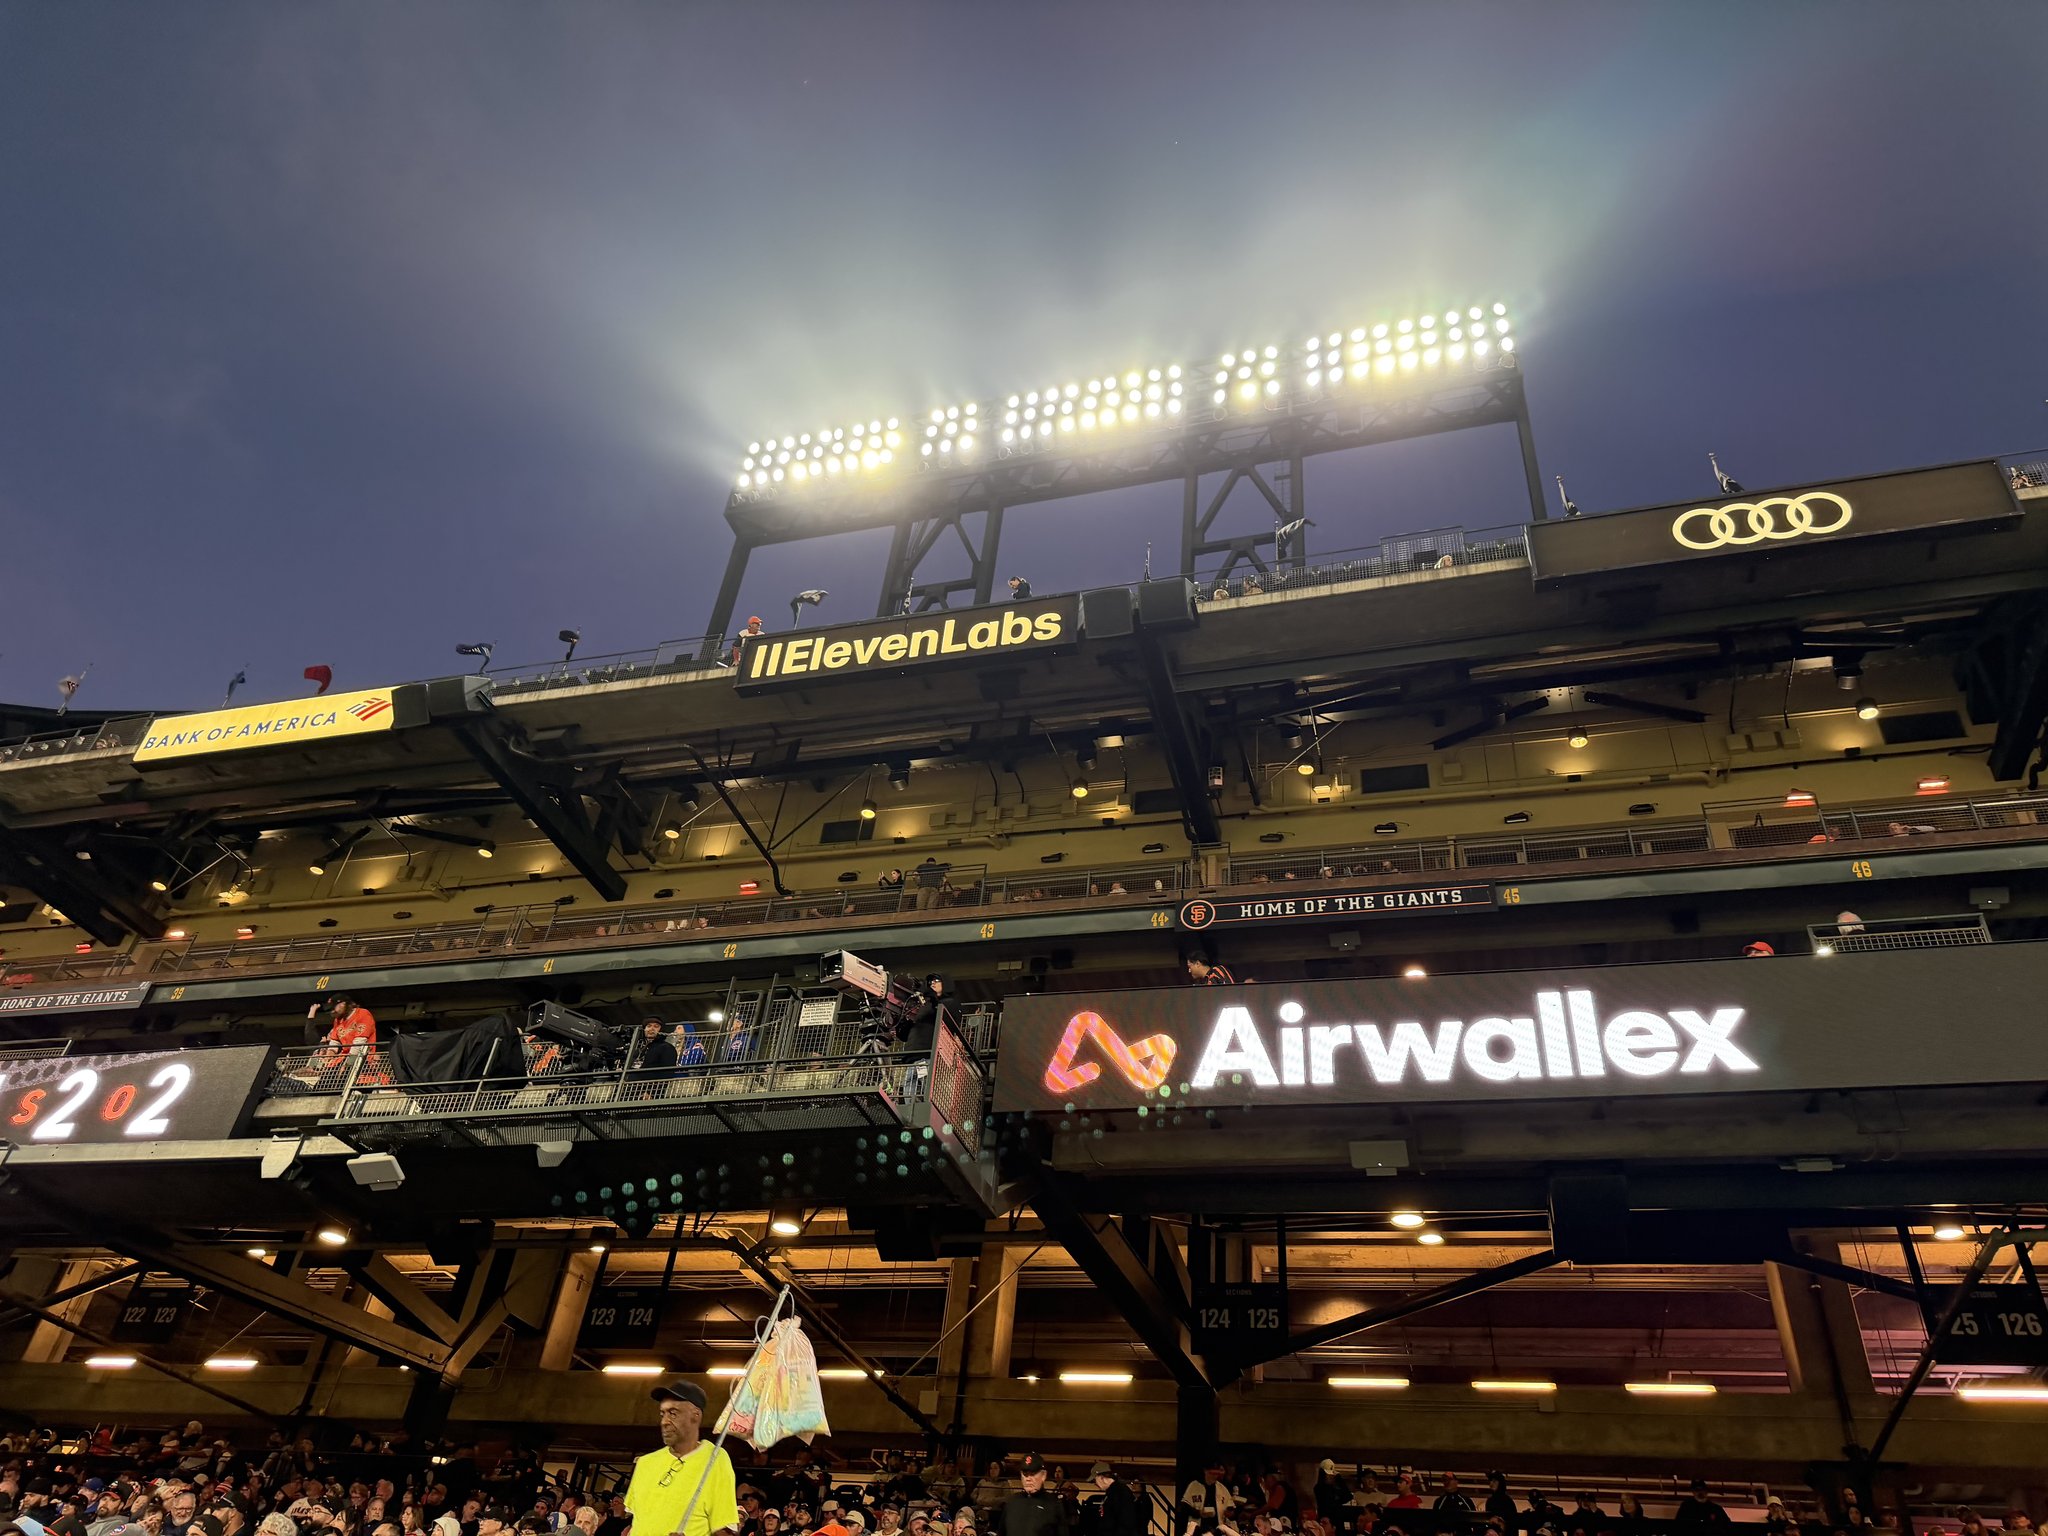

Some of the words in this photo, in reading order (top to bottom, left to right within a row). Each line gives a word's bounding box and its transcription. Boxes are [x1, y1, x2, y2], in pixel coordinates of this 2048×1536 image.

[143, 729, 204, 750] BANK
[207, 726, 236, 741] OF
[236, 711, 337, 738] AMERICA
[1852, 861, 1872, 878] 46
[1240, 902, 1296, 918] HOME
[1304, 900, 1327, 913] OF
[1335, 896, 1375, 911] THE
[1383, 890, 1462, 907] GIANTS
[1503, 888, 1520, 903] 45
[1151, 912, 1165, 927] 44
[980, 924, 994, 938] 43
[723, 944, 736, 958] 42
[543, 959, 554, 972] 41
[316, 976, 329, 989] 40
[0, 998, 34, 1010] HOME
[37, 996, 52, 1006] OF
[55, 994, 78, 1006] THE
[82, 991, 129, 1004] GIANTS
[1190, 989, 1759, 1088] Airwallex
[11, 1088, 47, 1124] S
[31, 1069, 98, 1139] 2
[124, 1063, 191, 1134] 2
[123, 1306, 147, 1322] 122
[153, 1307, 177, 1323] 123
[591, 1308, 616, 1326] 123
[628, 1308, 653, 1326] 124
[1200, 1308, 1230, 1328] 124
[1248, 1308, 1279, 1328] 125
[1951, 1312, 1979, 1335] 25
[1998, 1313, 2042, 1335] 126
